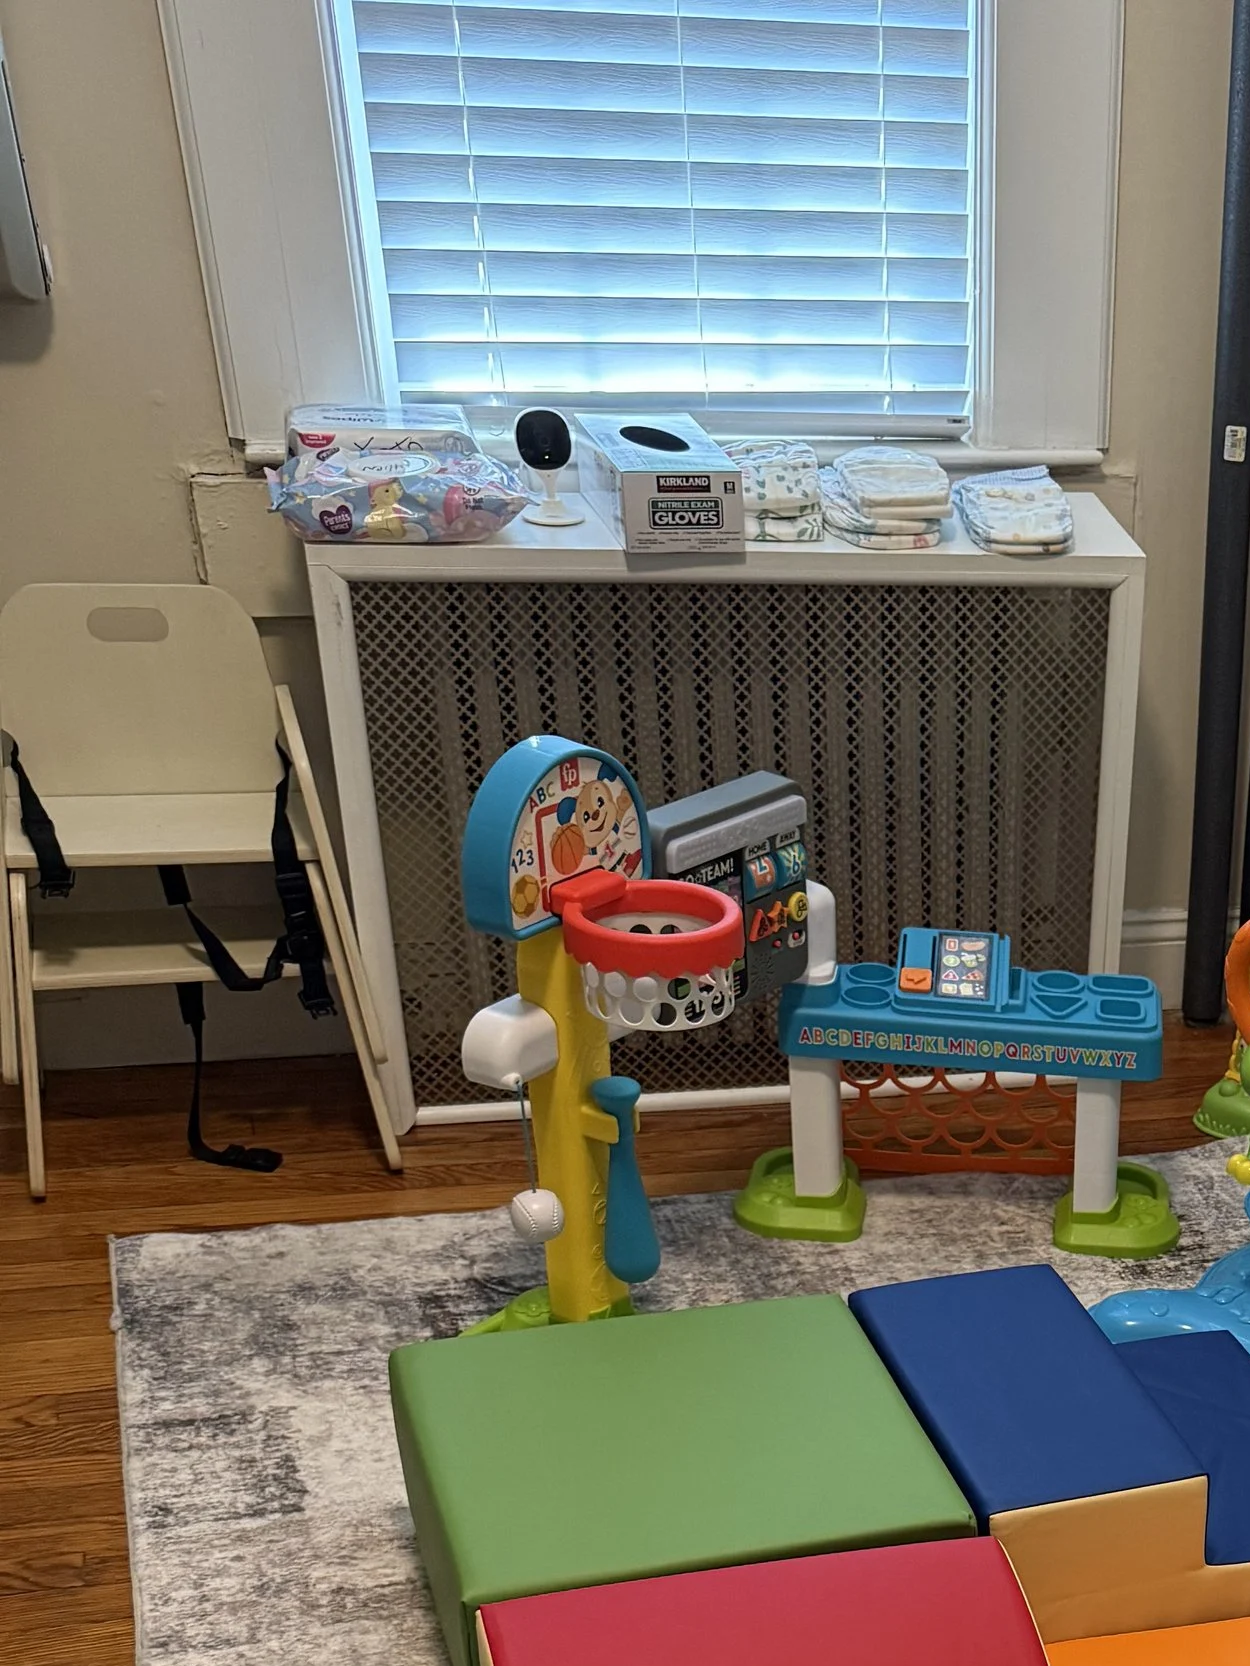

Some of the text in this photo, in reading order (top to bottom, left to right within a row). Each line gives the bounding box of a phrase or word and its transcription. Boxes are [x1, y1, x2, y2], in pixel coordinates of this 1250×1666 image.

[659, 477, 709, 487] KIRKLAND
[691, 501, 715, 509] EXAM
[654, 511, 718, 525] GLOVES
[528, 781, 556, 813] ABC
[748, 841, 767, 856] HOME
[511, 849, 534, 873] 123
[701, 857, 734, 883] TEAM!
